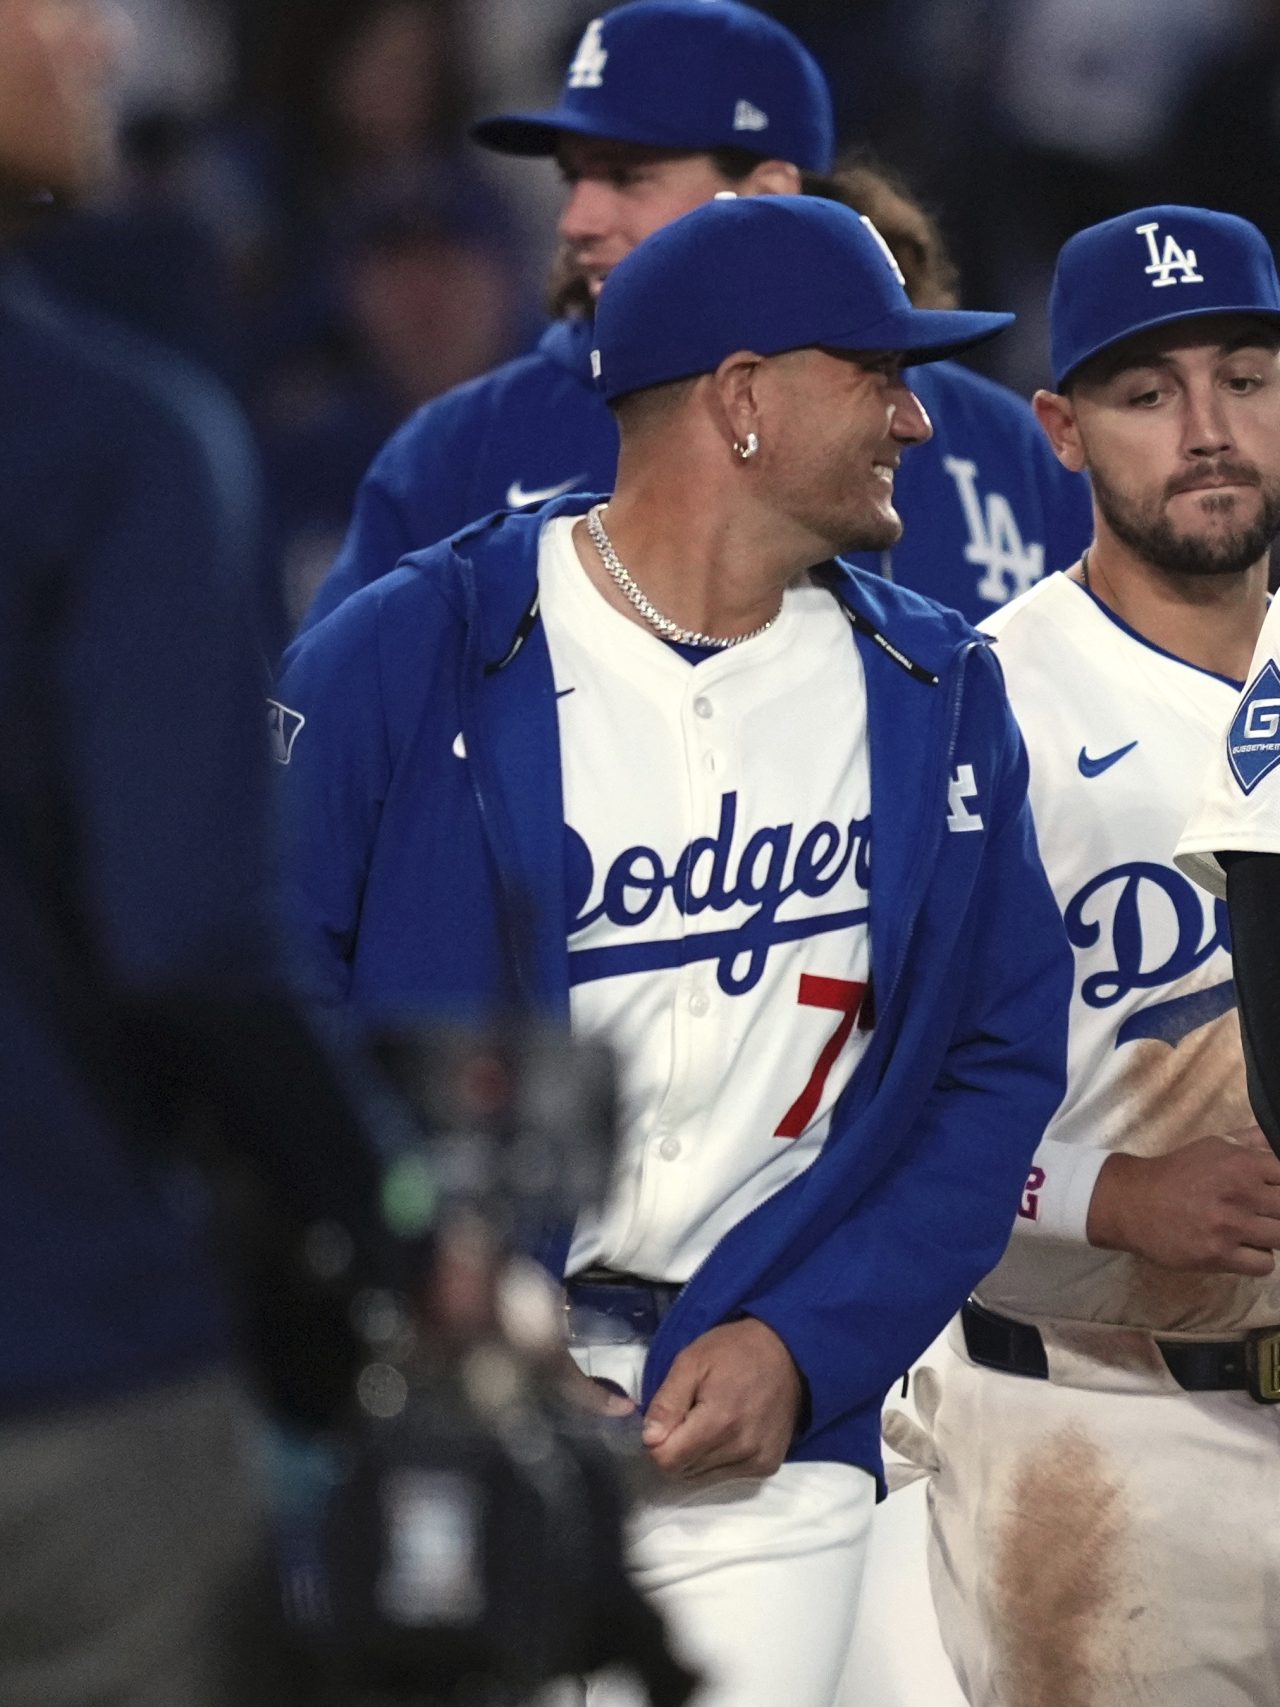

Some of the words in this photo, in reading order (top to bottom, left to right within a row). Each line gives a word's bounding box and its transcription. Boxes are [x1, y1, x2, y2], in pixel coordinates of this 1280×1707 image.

[1135, 222, 1204, 287] LA
[943, 454, 1045, 604] LA
[565, 790, 872, 996] odger
[773, 973, 876, 1138] 7
